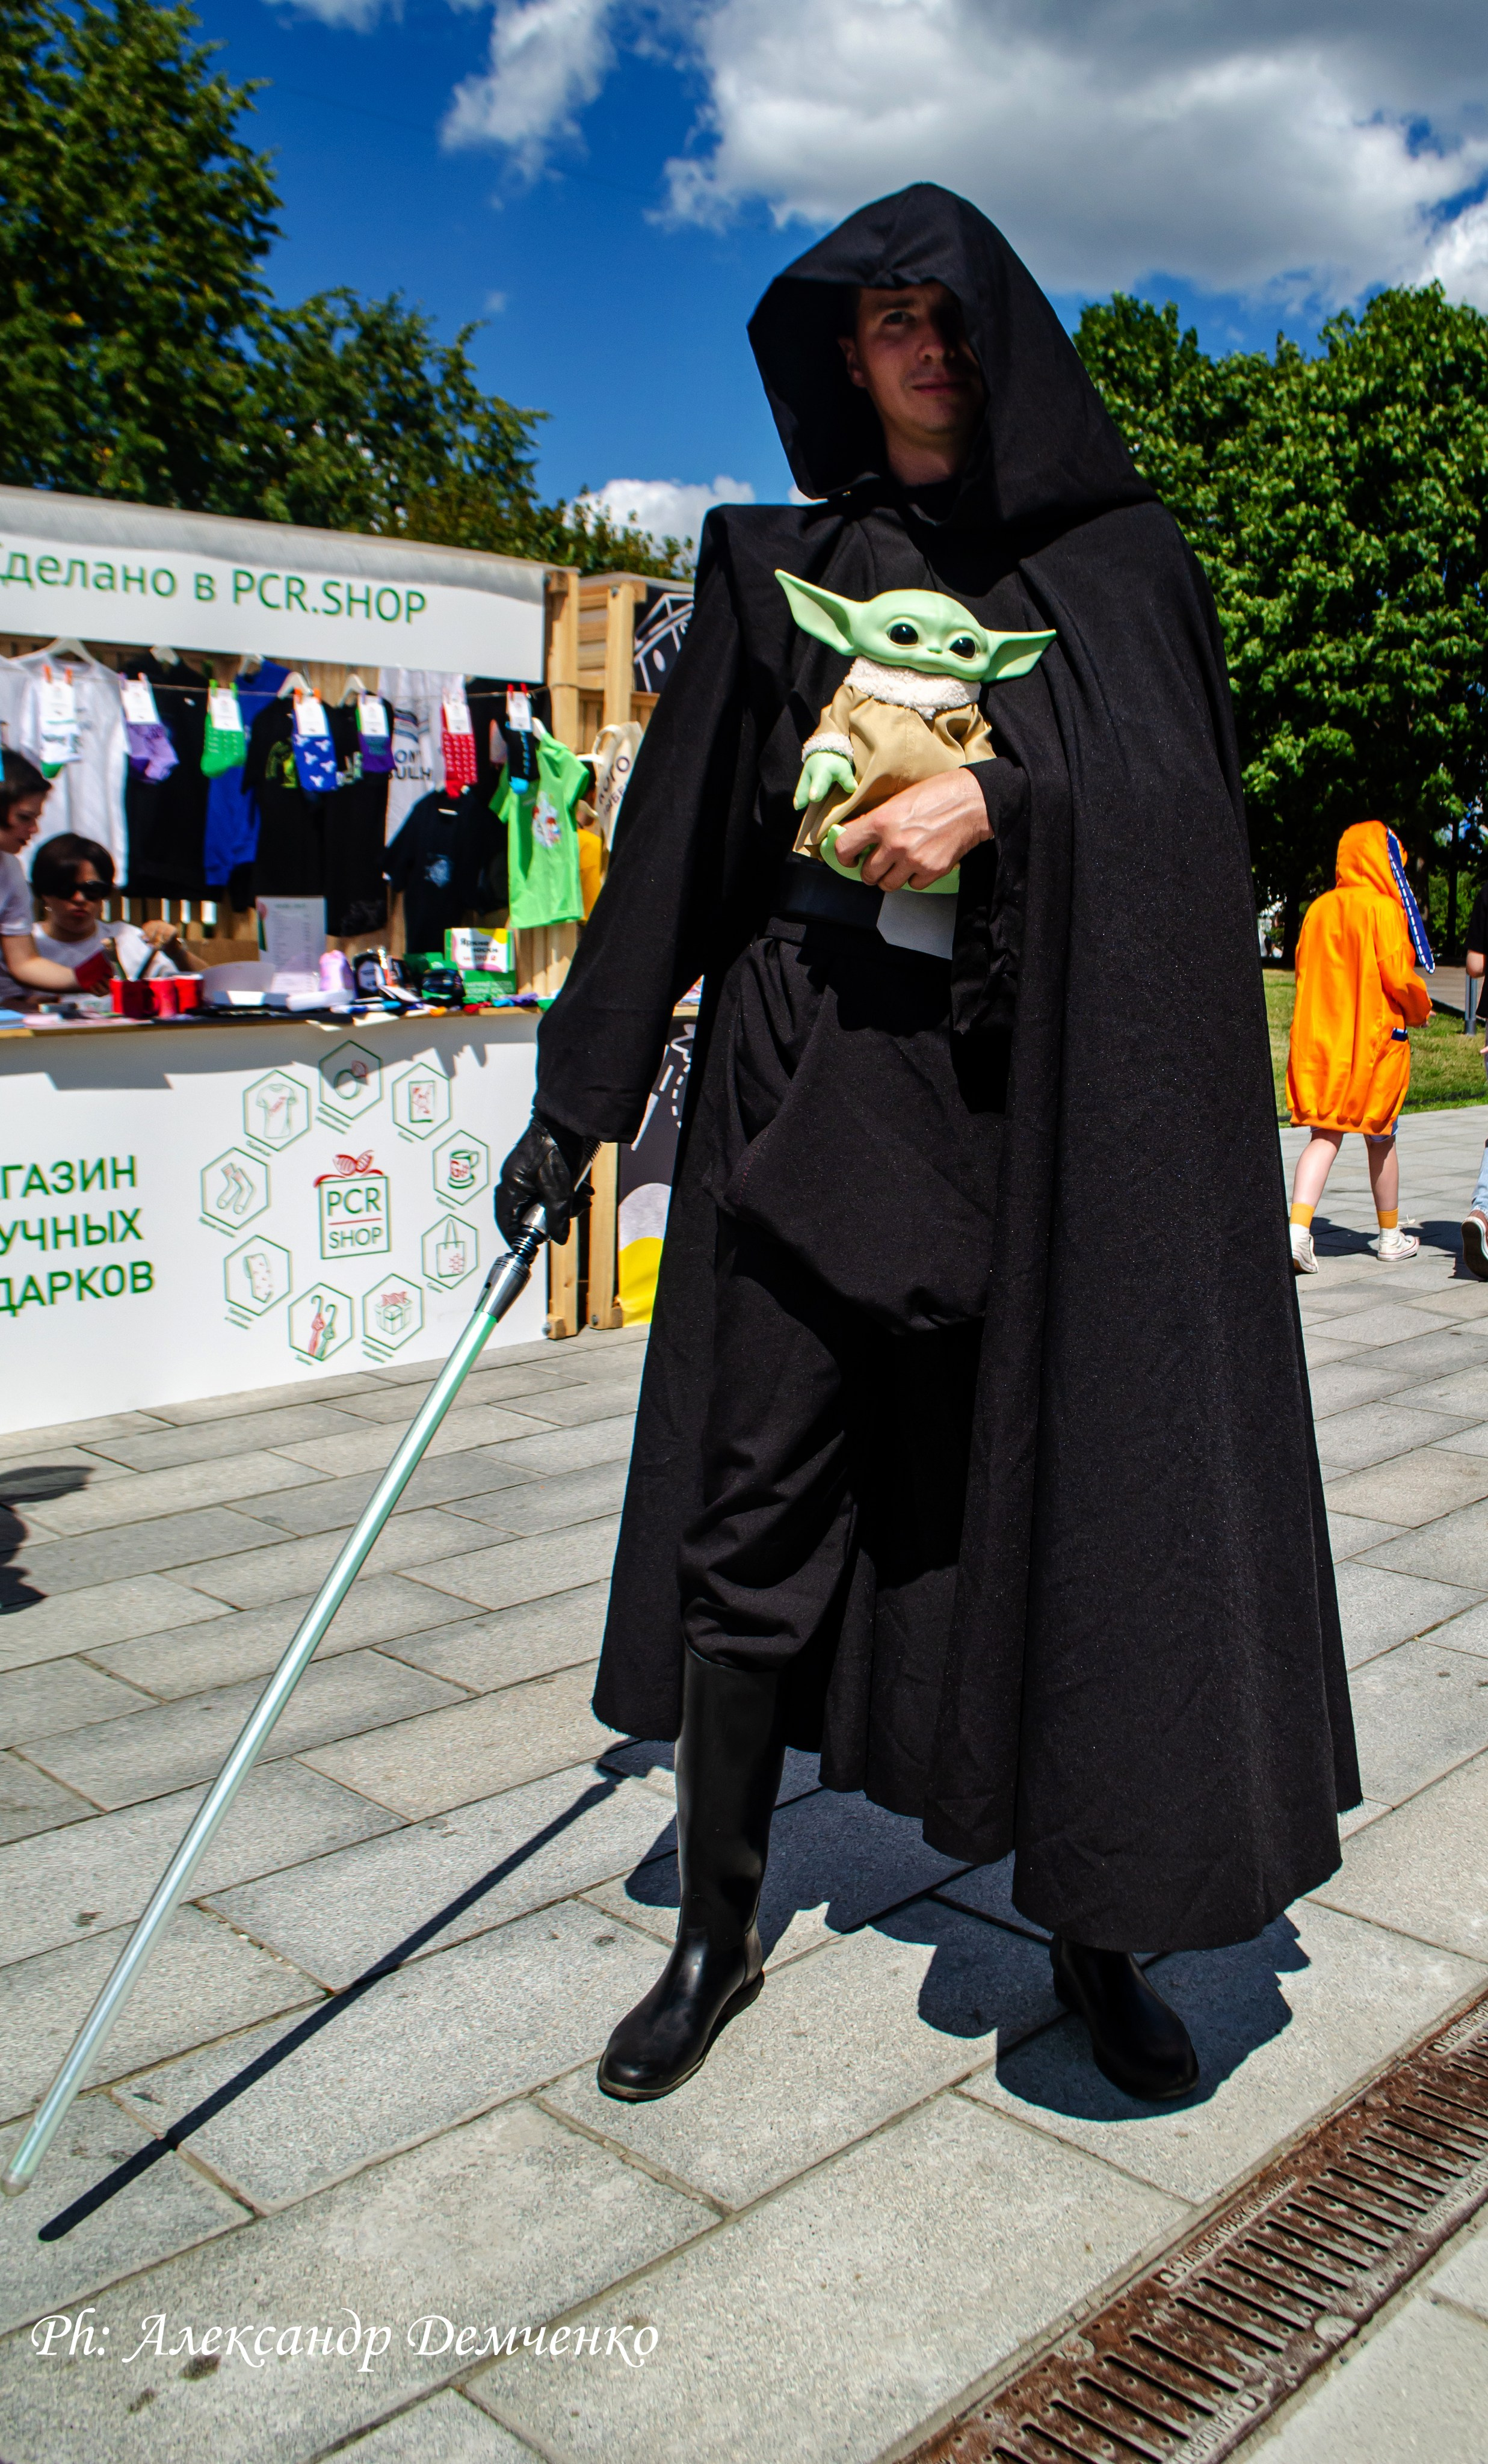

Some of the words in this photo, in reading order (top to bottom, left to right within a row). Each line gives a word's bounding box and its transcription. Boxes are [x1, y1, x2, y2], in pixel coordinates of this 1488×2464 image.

[0, 543, 176, 597] делано
[193, 572, 216, 602] в
[232, 568, 427, 624] PCR.SHOP
[0, 1154, 136, 1200] ГАЗИН
[327, 1187, 382, 1216] PCR
[0, 1207, 143, 1255] УЧНЫХ
[328, 1227, 383, 1249] SHOP
[0, 1260, 154, 1318] ДАРКОВ
